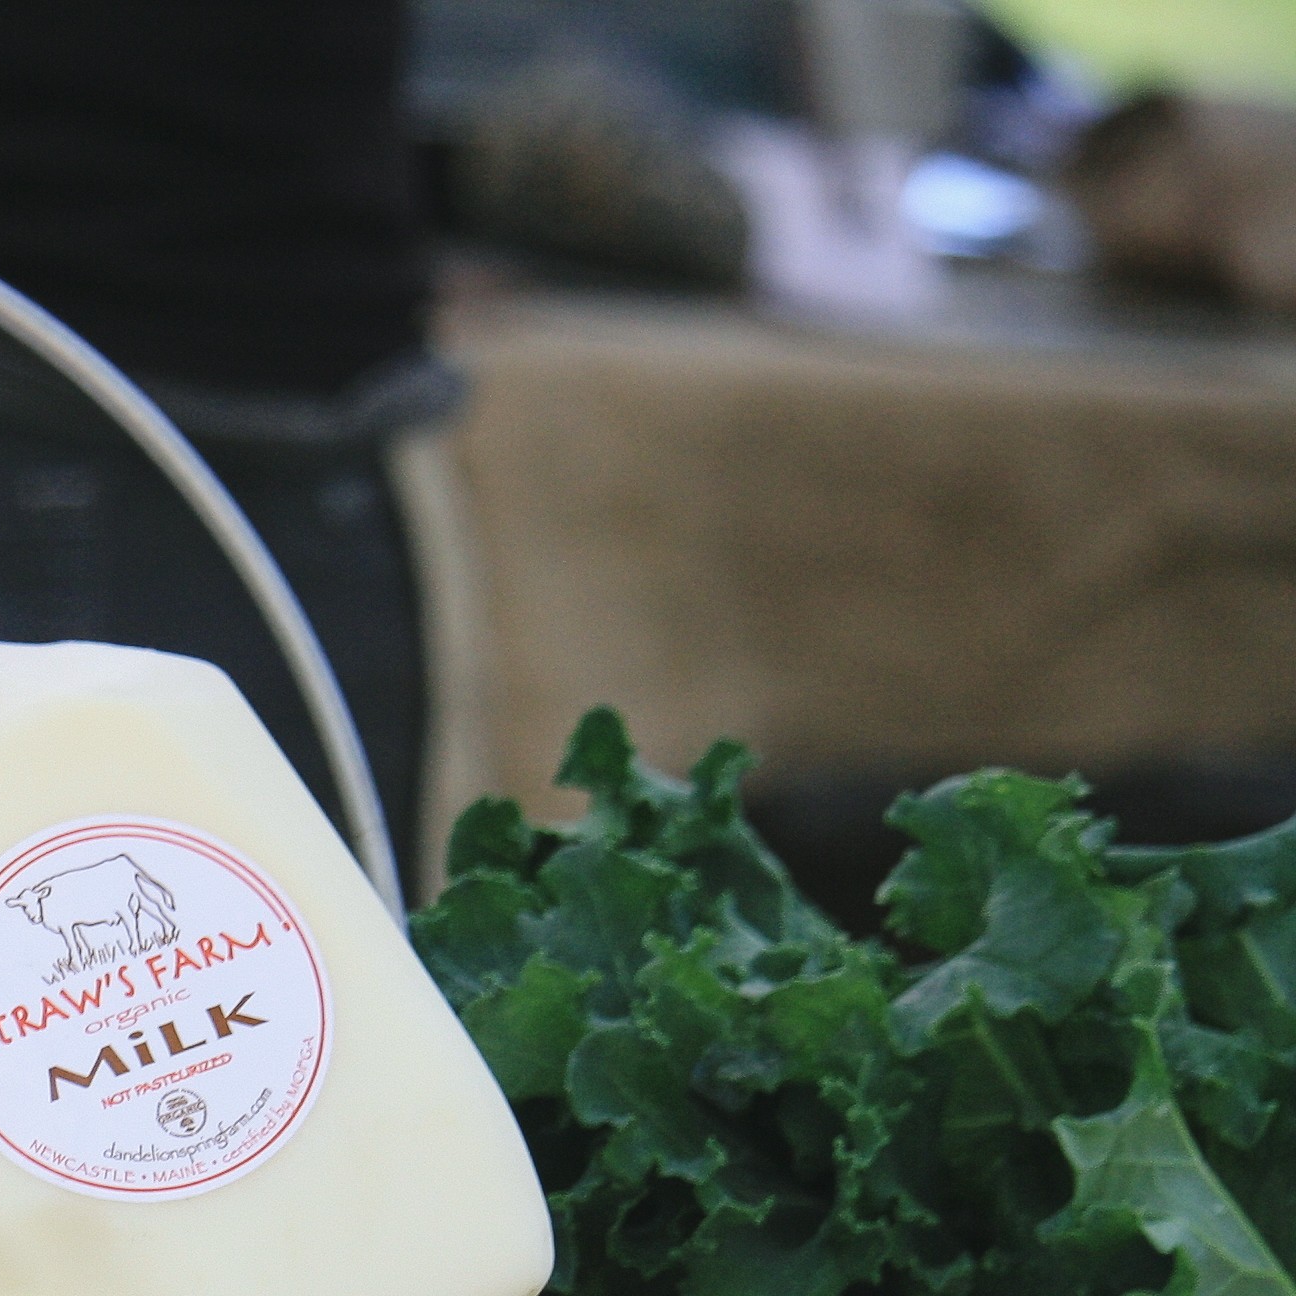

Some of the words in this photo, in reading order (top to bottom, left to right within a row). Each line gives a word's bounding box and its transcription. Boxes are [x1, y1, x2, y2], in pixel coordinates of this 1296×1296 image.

[145, 922, 272, 988] FARM
[84, 988, 191, 1035] organic
[101, 1087, 131, 1109] NOT
[134, 1052, 233, 1096] PASTEURIZED
[29, 1139, 136, 1184] NEWCASTLE
[152, 1161, 209, 1183] MAINE
[223, 1111, 277, 1163] certified
[269, 1099, 293, 1120] by
[103, 1087, 273, 1163] dandelionspringfarm.com
